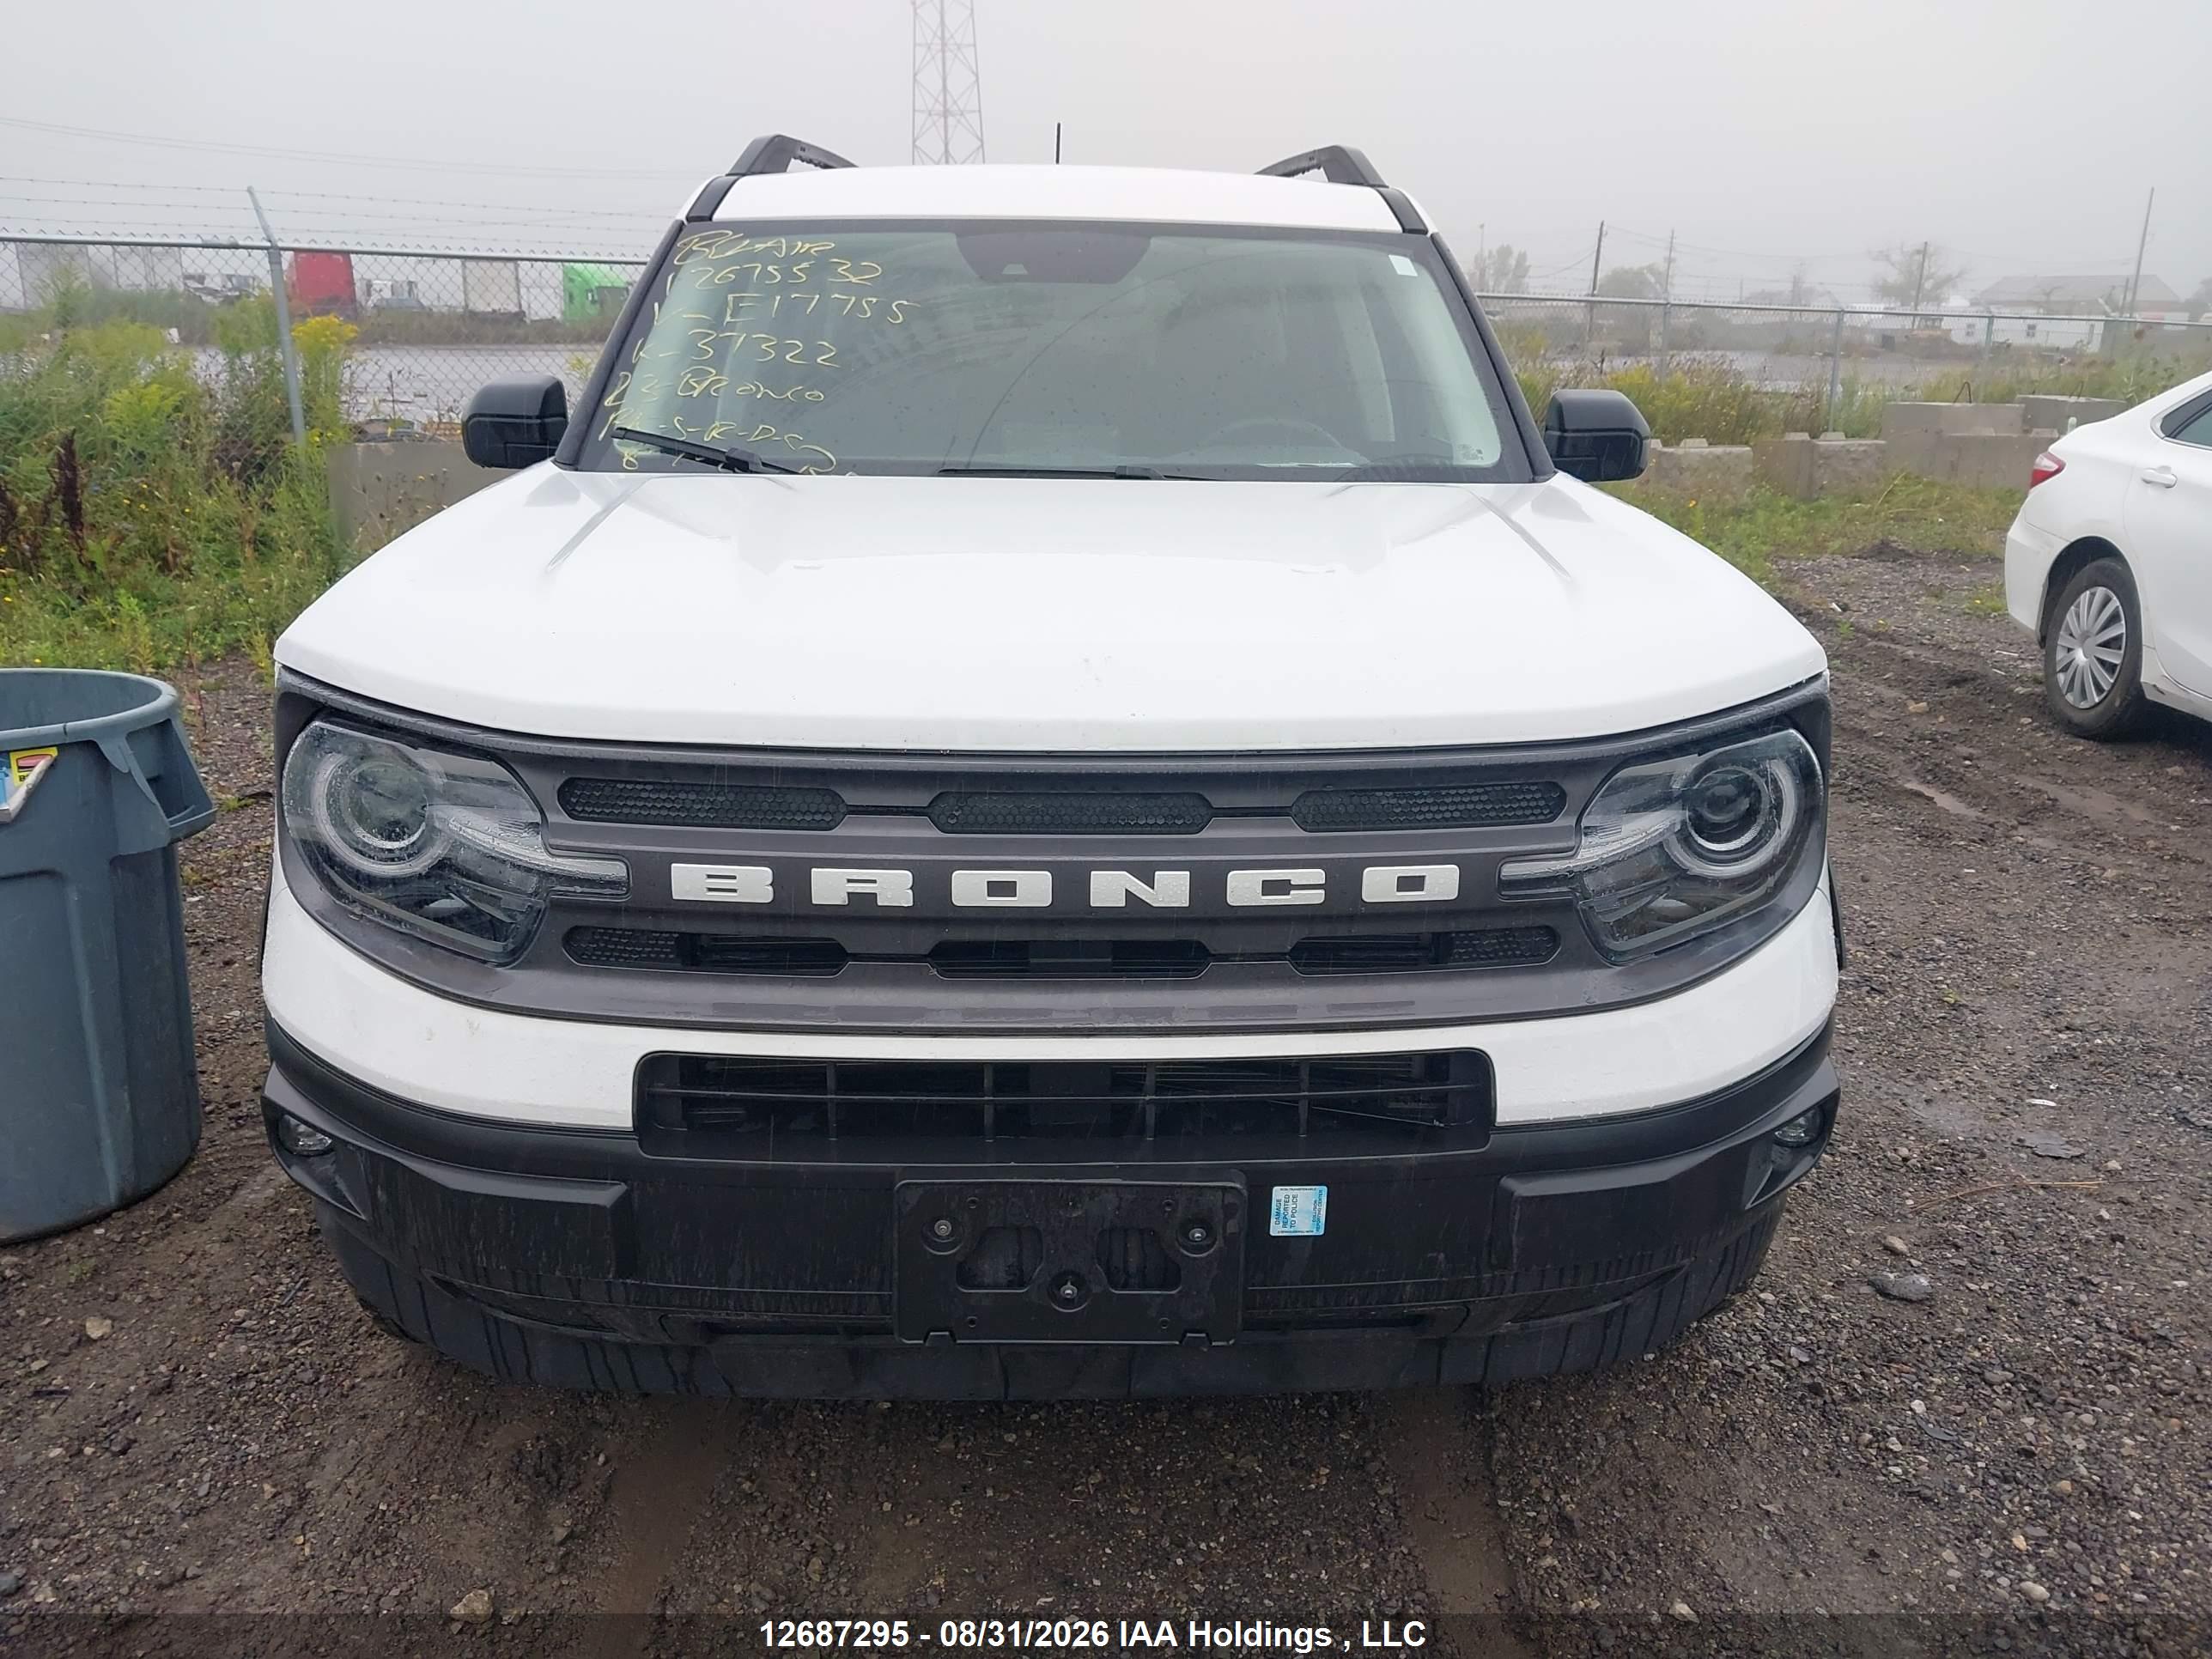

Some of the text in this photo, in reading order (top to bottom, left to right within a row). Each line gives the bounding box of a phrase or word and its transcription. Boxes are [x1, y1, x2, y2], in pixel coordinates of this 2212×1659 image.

[671, 864, 1460, 908] BRONCO
[1282, 1194, 1291, 1229] REPORTED
[1290, 1218, 1297, 1229] TO
